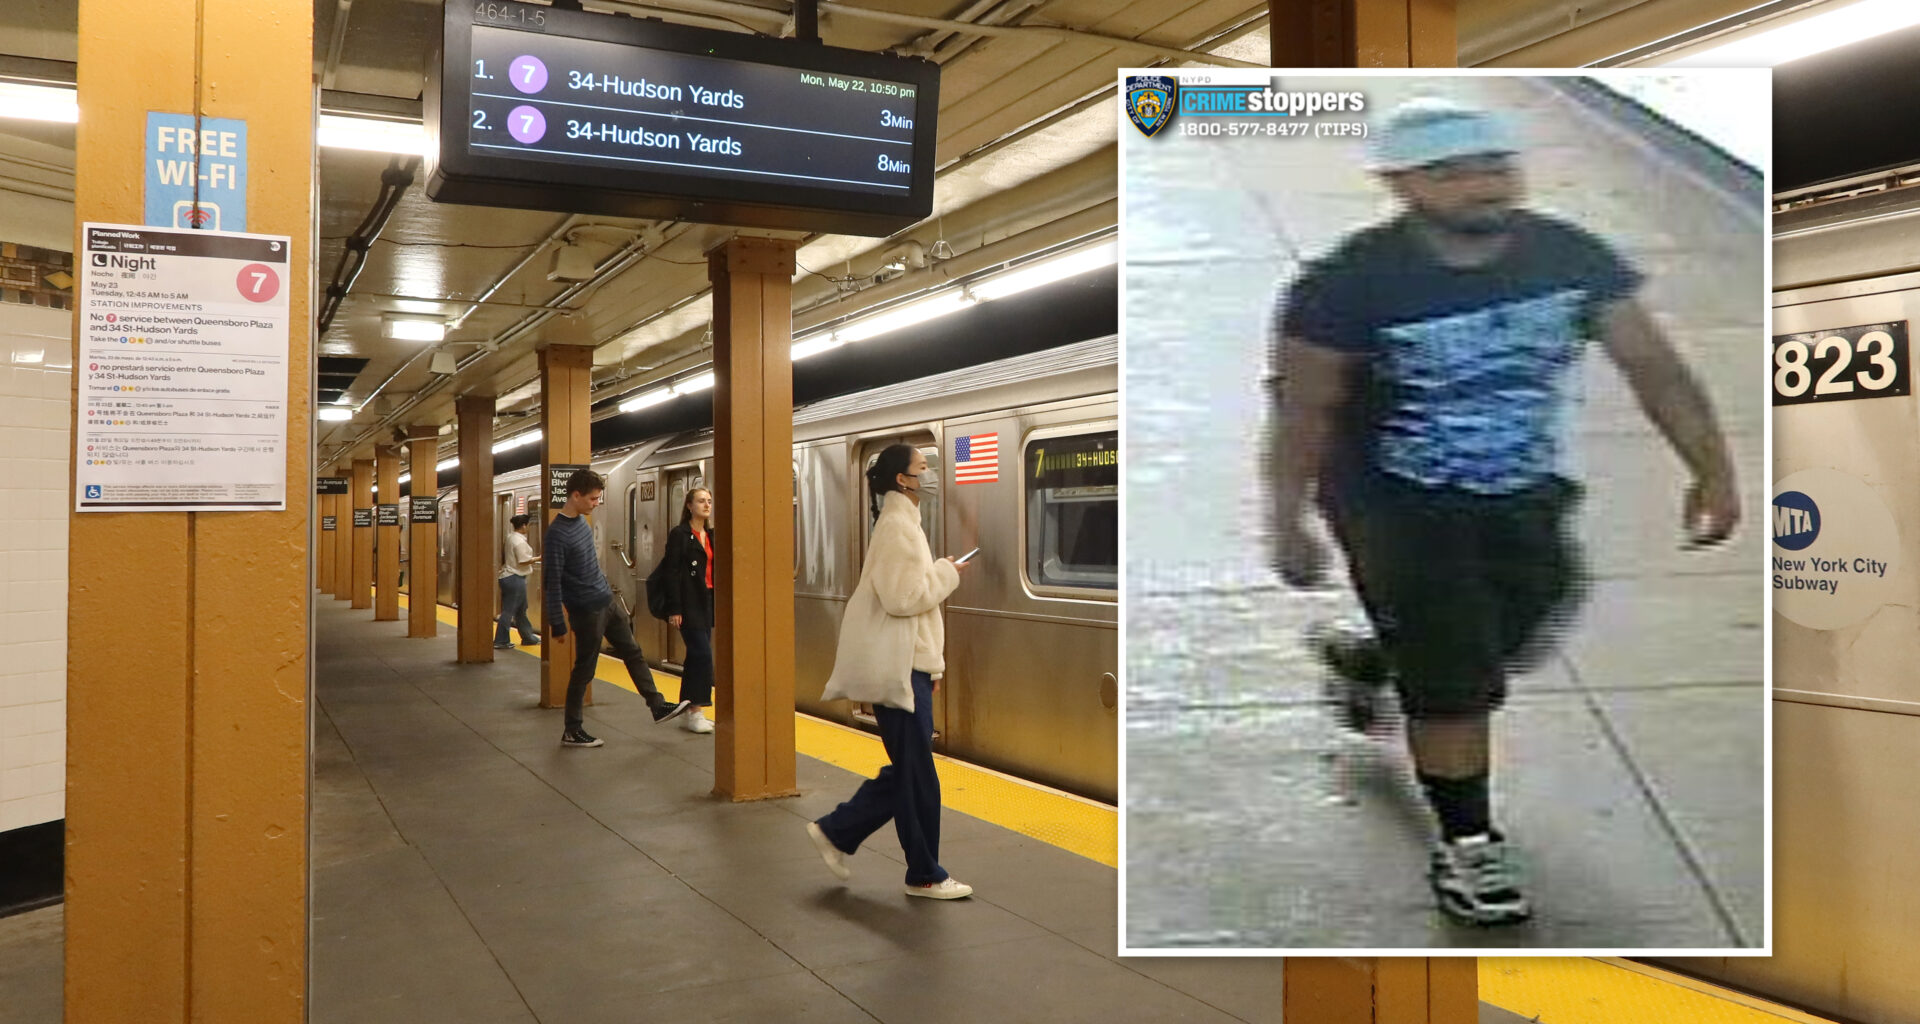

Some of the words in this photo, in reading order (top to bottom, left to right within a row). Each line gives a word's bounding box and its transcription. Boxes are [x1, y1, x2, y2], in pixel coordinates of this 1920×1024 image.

[475, 2, 545, 26] 464-1-5
[475, 59, 494, 80] 1.
[521, 65, 536, 84] 7
[568, 70, 682, 101] 34-Hudson
[689, 85, 744, 109] Yards
[800, 73, 825, 87] Mon,
[828, 76, 849, 92] May
[852, 80, 867, 93] 22,
[870, 83, 897, 96] 10:50
[900, 88, 915, 99] pm
[880, 110, 913, 130] 3Min
[157, 126, 237, 158] FREE
[472, 109, 493, 130] 2.
[520, 115, 534, 134] 7
[566, 120, 680, 149] 34-Hudson
[687, 132, 742, 156] Yards
[877, 154, 910, 174] 8Min
[156, 159, 235, 190] WI-FI
[92, 230, 120, 238] Planned
[111, 255, 156, 272] Night
[91, 281, 106, 289] May
[250, 272, 267, 293] 7
[91, 289, 125, 298] Tuesday,
[90, 300, 129, 308] STATION
[131, 301, 203, 311] IMPROVEMENTS
[90, 313, 104, 321] No
[119, 315, 152, 323] service
[154, 316, 192, 325] between
[194, 316, 249, 328] Queensboro
[250, 319, 273, 329] Plaza
[109, 324, 120, 332] 34
[122, 324, 171, 334] St-Hudson
[173, 326, 198, 335] Yards
[198, 366, 244, 375] Queensboro
[245, 368, 265, 376] Plaza
[1772, 331, 1897, 397] 823
[1035, 448, 1045, 478] 7
[551, 470, 574, 478] Vern
[551, 494, 568, 503] Ave
[641, 482, 653, 499] 7823
[1772, 504, 1813, 540] MTA
[1772, 556, 1806, 572] New
[1810, 556, 1848, 574] York
[1853, 557, 1887, 578] City
[1772, 573, 1838, 595] Subway
